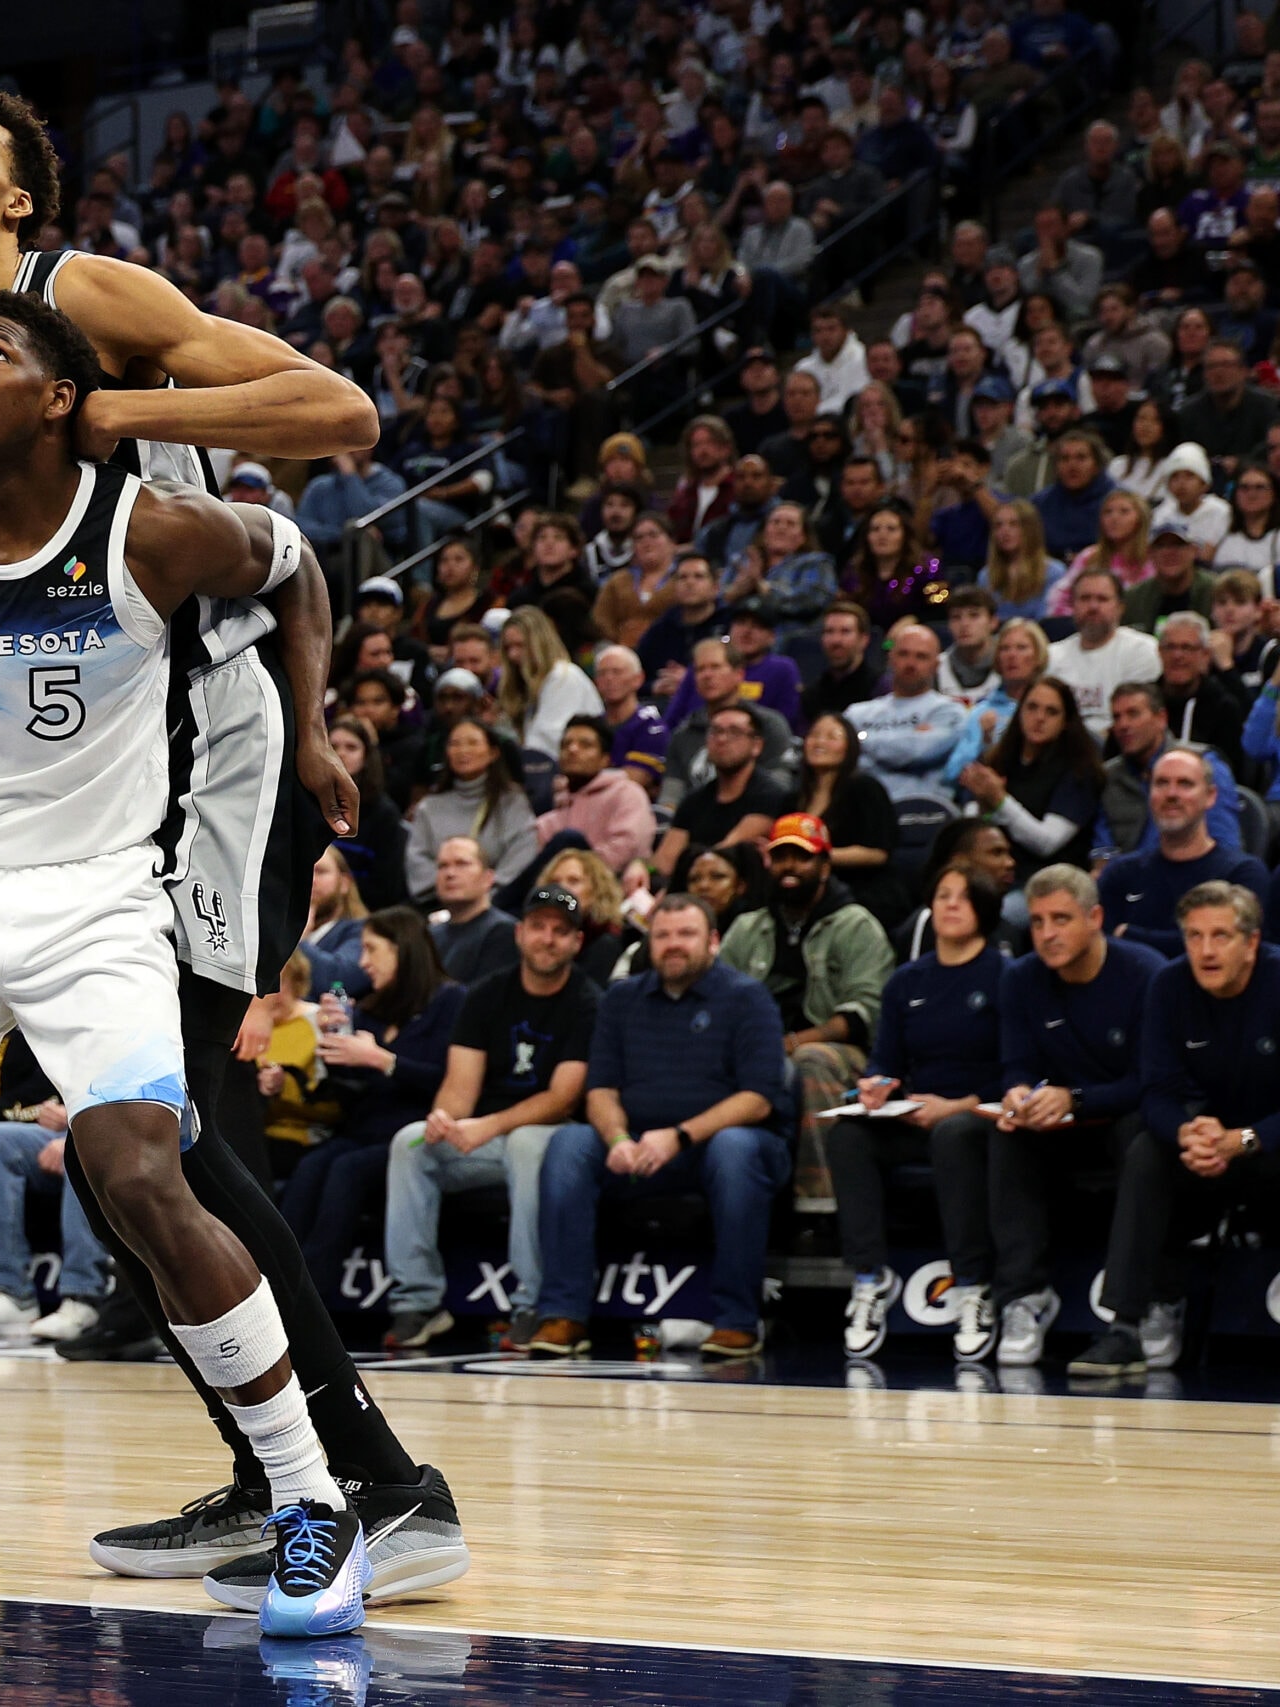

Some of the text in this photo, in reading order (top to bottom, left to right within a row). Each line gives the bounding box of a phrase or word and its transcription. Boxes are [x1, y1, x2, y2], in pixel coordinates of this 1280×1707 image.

[47, 581, 104, 597] sezzle
[25, 665, 86, 741] 5
[220, 1338, 240, 1358] 5
